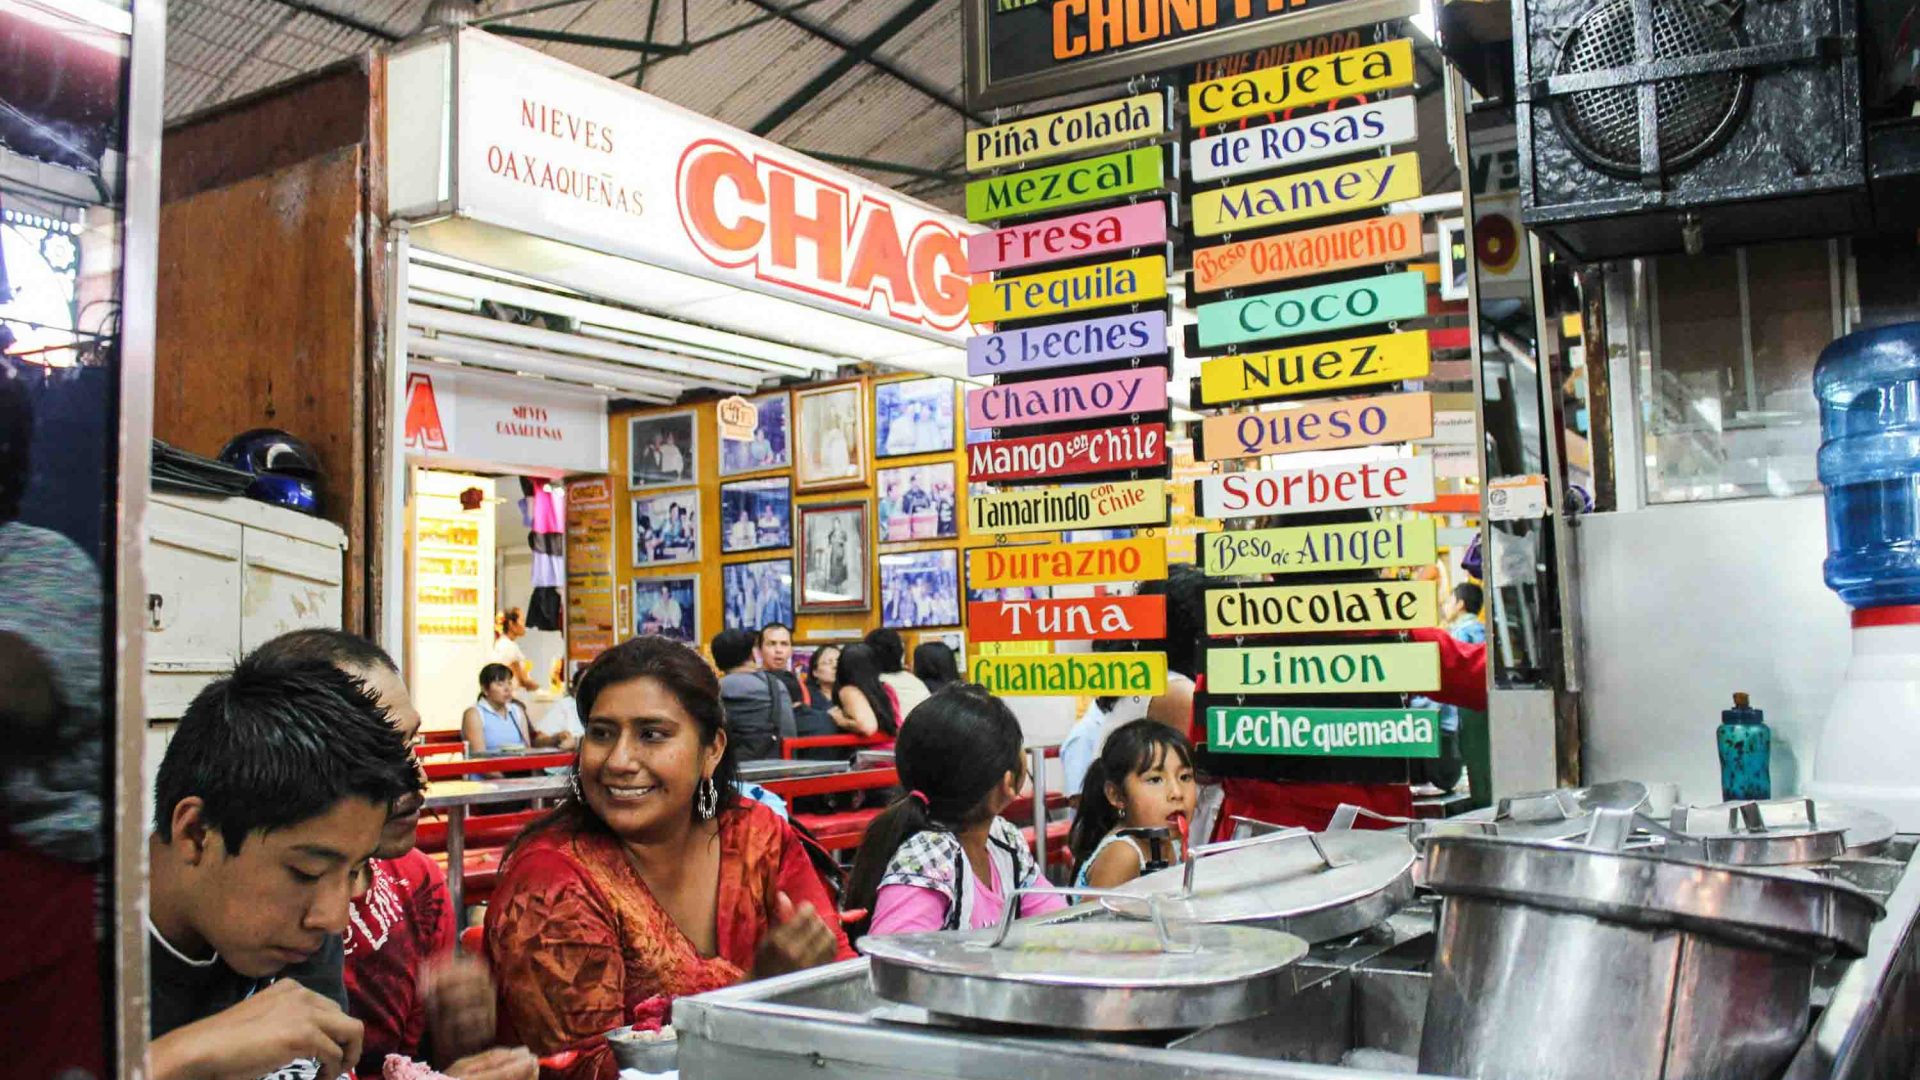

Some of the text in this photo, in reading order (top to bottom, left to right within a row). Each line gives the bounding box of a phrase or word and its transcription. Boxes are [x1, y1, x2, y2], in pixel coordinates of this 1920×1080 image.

[1053, 0, 1306, 59] CHON
[521, 98, 615, 154] NIEVES
[977, 126, 1039, 162] Piña
[1048, 101, 1151, 147] Colada
[1211, 136, 1251, 168] de
[1262, 108, 1387, 160] Rosas
[486, 146, 645, 217] OAXAQUEÑAS
[985, 154, 1135, 213] Mezcal
[1216, 165, 1395, 225] Mamey
[676, 138, 986, 332] CHAG
[996, 216, 1123, 262] Fresa
[1195, 220, 1407, 284] Beso Oaxaqueño
[994, 266, 1137, 312] Tequila
[1239, 288, 1379, 332] Coco
[985, 320, 1150, 366] 3 Leches
[1242, 345, 1379, 391] Nuez
[981, 377, 1142, 421] Chamoy
[971, 427, 1158, 476] Mango con Chile
[1237, 406, 1388, 453] Queso
[973, 484, 1146, 528] Tamarindo con Chile
[1222, 464, 1408, 510] Sorbete
[986, 546, 1141, 581] Durazno
[1211, 524, 1404, 573] Beso de Angel
[1000, 601, 1134, 635] Tuna
[1216, 588, 1418, 627] Chocolate
[974, 657, 1152, 692] Guanabana
[1240, 651, 1386, 686] Limon
[1215, 710, 1434, 752] Leche quemada
